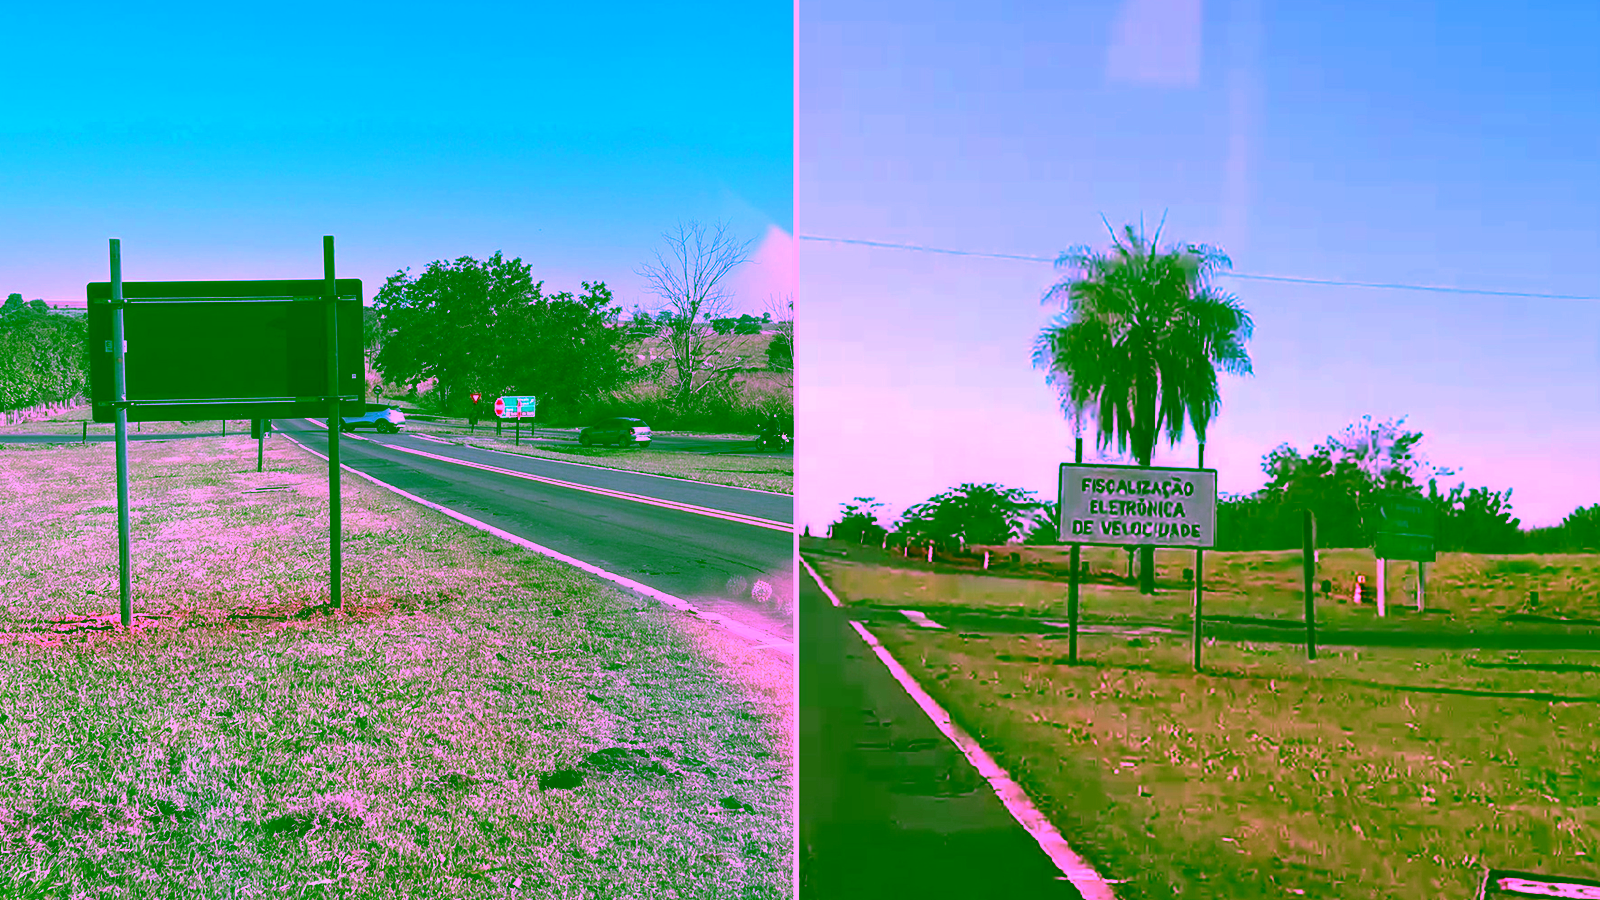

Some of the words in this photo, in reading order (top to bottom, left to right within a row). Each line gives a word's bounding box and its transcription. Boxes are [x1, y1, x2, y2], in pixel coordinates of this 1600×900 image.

[1081, 477, 1194, 499] FISCALIZAÇÃO
[1090, 498, 1186, 518] ELETRÔNICA
[1072, 520, 1094, 535] DE
[1101, 520, 1201, 538] VELOCIDADE
